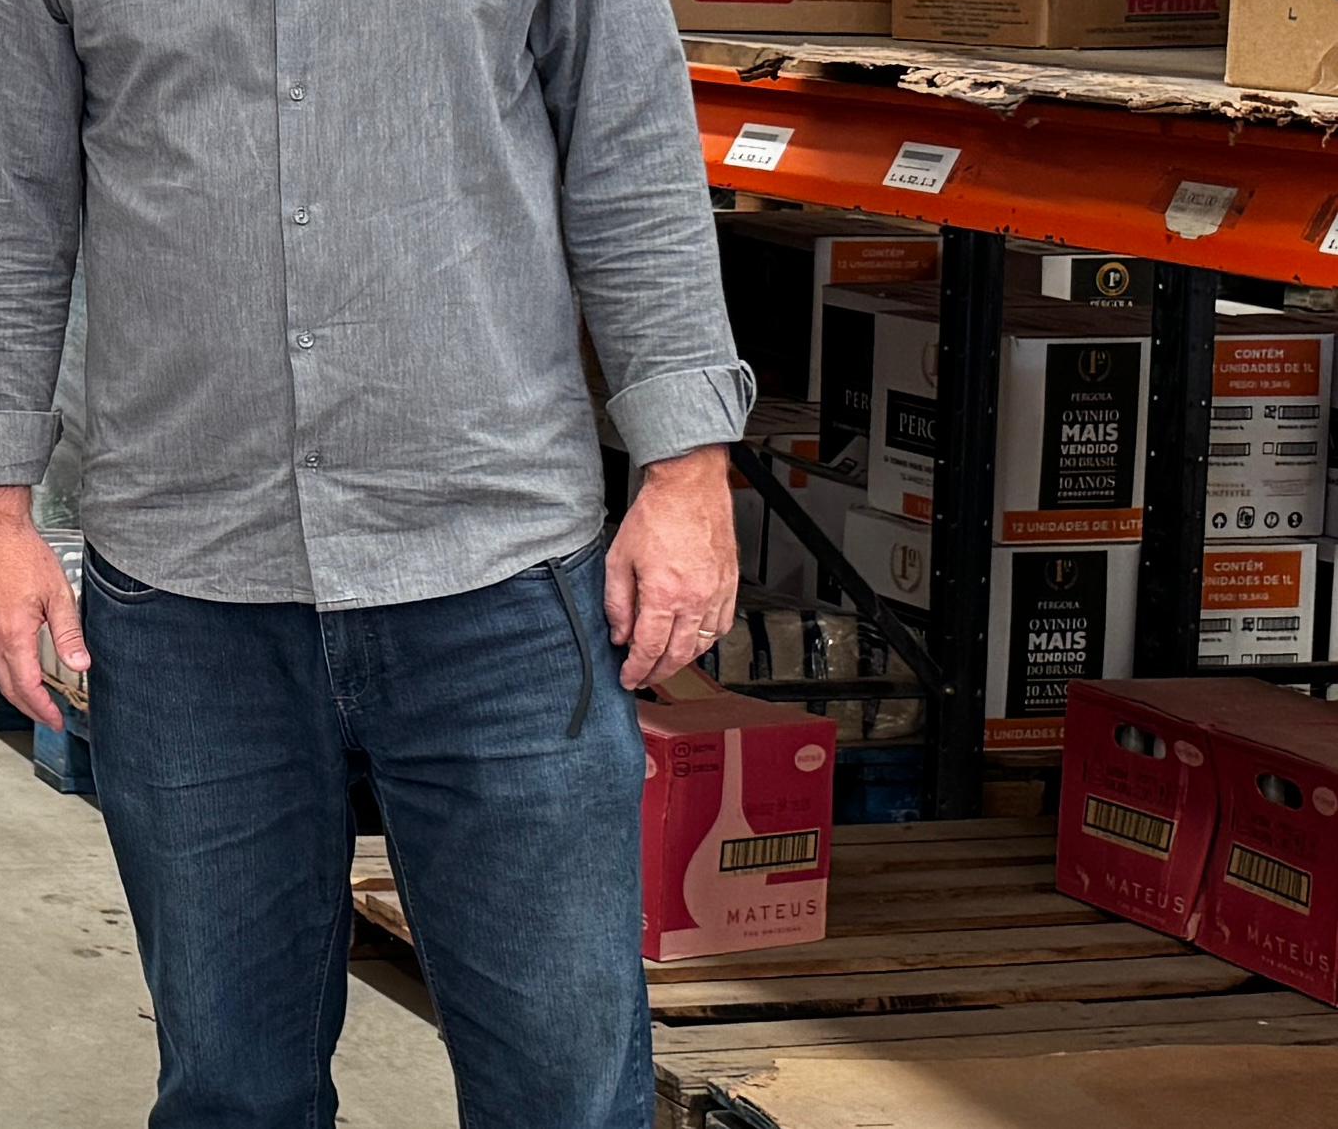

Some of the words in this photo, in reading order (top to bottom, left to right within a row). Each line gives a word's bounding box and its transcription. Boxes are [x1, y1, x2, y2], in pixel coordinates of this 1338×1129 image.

[1234, 347, 1284, 359] CONTÉM
[1220, 364, 1281, 373] UNIDADES
[1071, 392, 1113, 402] PERGOLA
[1062, 410, 1073, 422] O
[1076, 409, 1119, 422] VINHO
[1061, 424, 1119, 442] MAIS
[1061, 443, 1118, 455] VENDIDO
[1059, 457, 1076, 468] DO
[1078, 456, 1117, 468] BRASIL
[1059, 476, 1073, 489] 10
[1075, 475, 1116, 489] ANOS
[1012, 522, 1023, 532] 12
[1027, 521, 1089, 533] UNIDADES
[1092, 521, 1109, 531] DE
[1213, 560, 1263, 571] CONTÉM
[1263, 575, 1280, 585] DE
[1037, 601, 1080, 610] PERGOLA
[1029, 619, 1040, 631] O
[1043, 618, 1087, 630] VINHO
[1028, 632, 1086, 650] MAIS
[1027, 652, 1086, 663] VENDIDO
[1027, 665, 1043, 676] DO
[1045, 664, 1085, 675] BRASIL
[1026, 686, 1040, 697] 10
[993, 728, 1056, 741] UNIDADES
[1106, 873, 1185, 915] MATEUS
[726, 899, 817, 925] MATEUS
[1248, 925, 1330, 972] MATEUS
